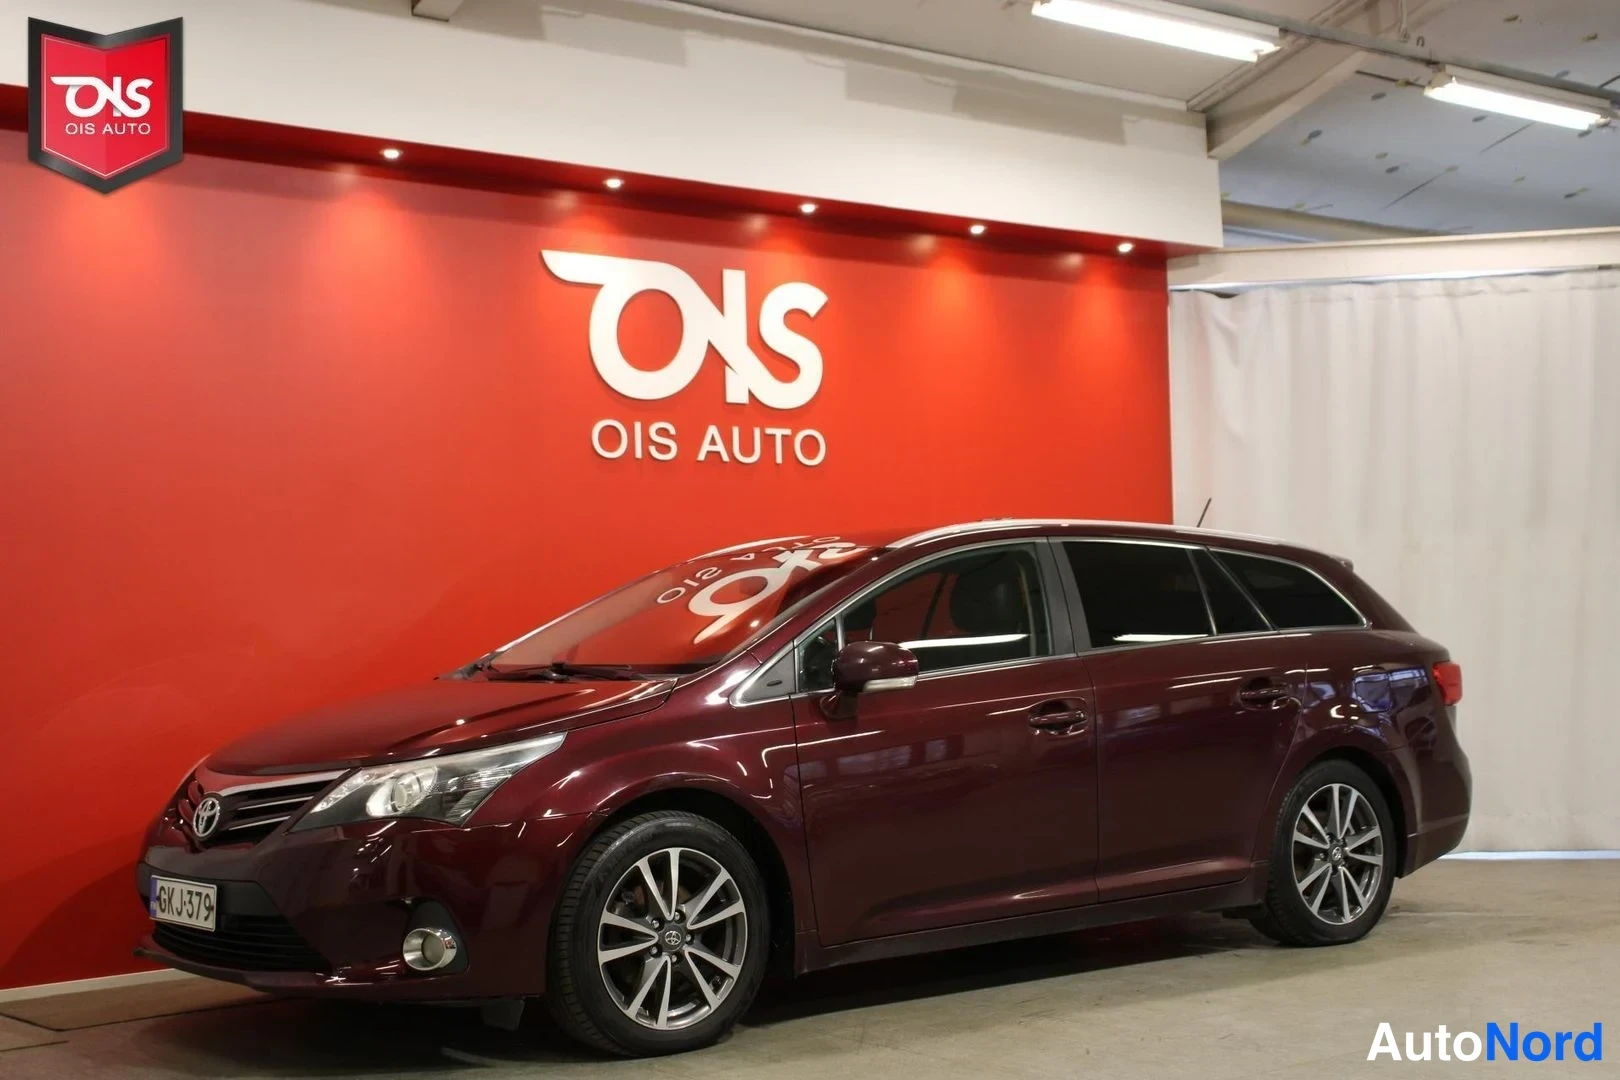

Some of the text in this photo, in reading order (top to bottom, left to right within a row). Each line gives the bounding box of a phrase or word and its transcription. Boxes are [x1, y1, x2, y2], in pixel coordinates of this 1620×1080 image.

[591, 419, 827, 466] OIS AUTO
[159, 886, 212, 921] GKJ-379
